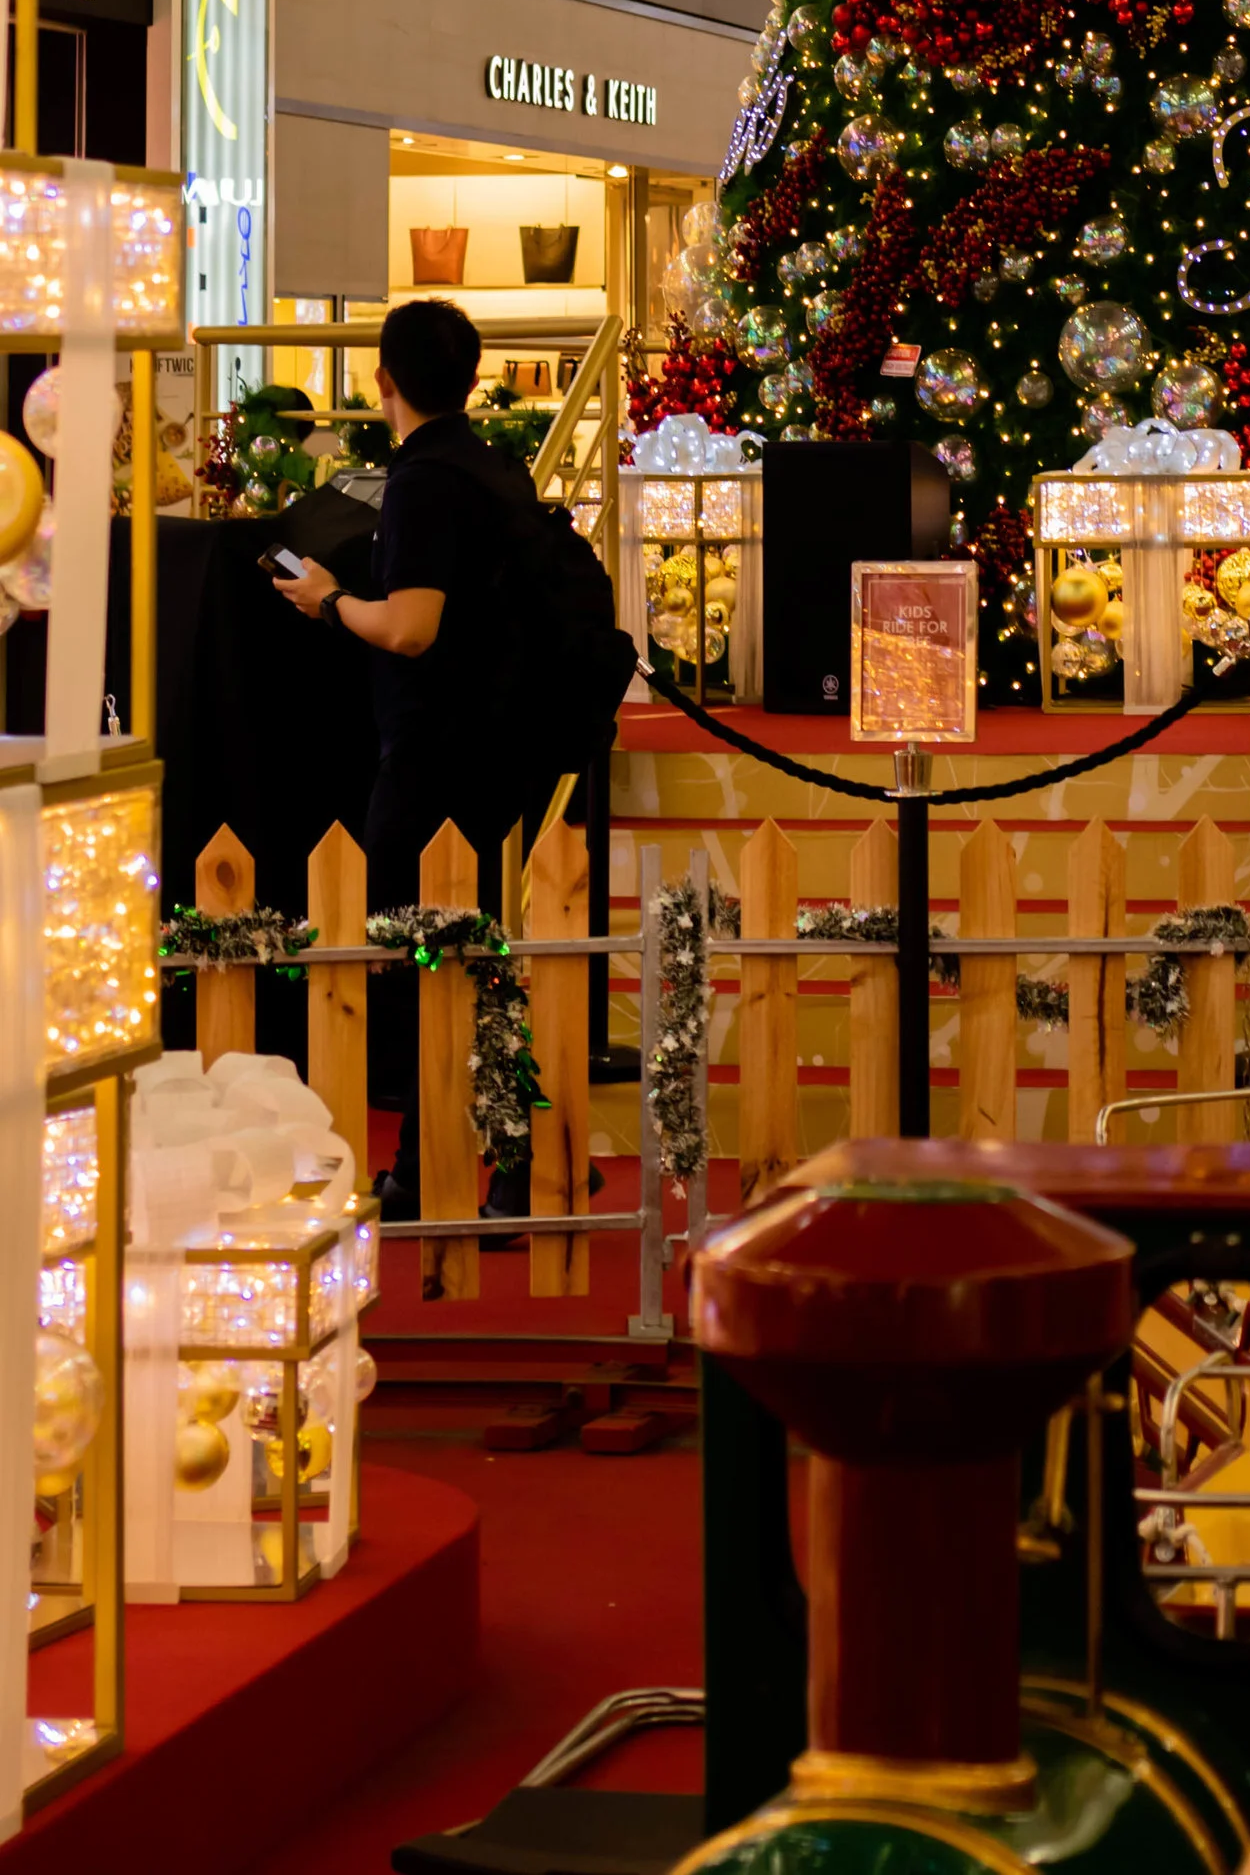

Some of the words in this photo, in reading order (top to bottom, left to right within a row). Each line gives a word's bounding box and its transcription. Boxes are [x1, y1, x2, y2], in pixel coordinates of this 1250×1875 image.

[487, 54, 575, 113] CHARLES
[583, 73, 598, 116] &
[606, 78, 657, 126] KEITH
[899, 605, 932, 619] KIDS
[883, 620, 914, 634] RIDE
[919, 620, 948, 634] FOR
